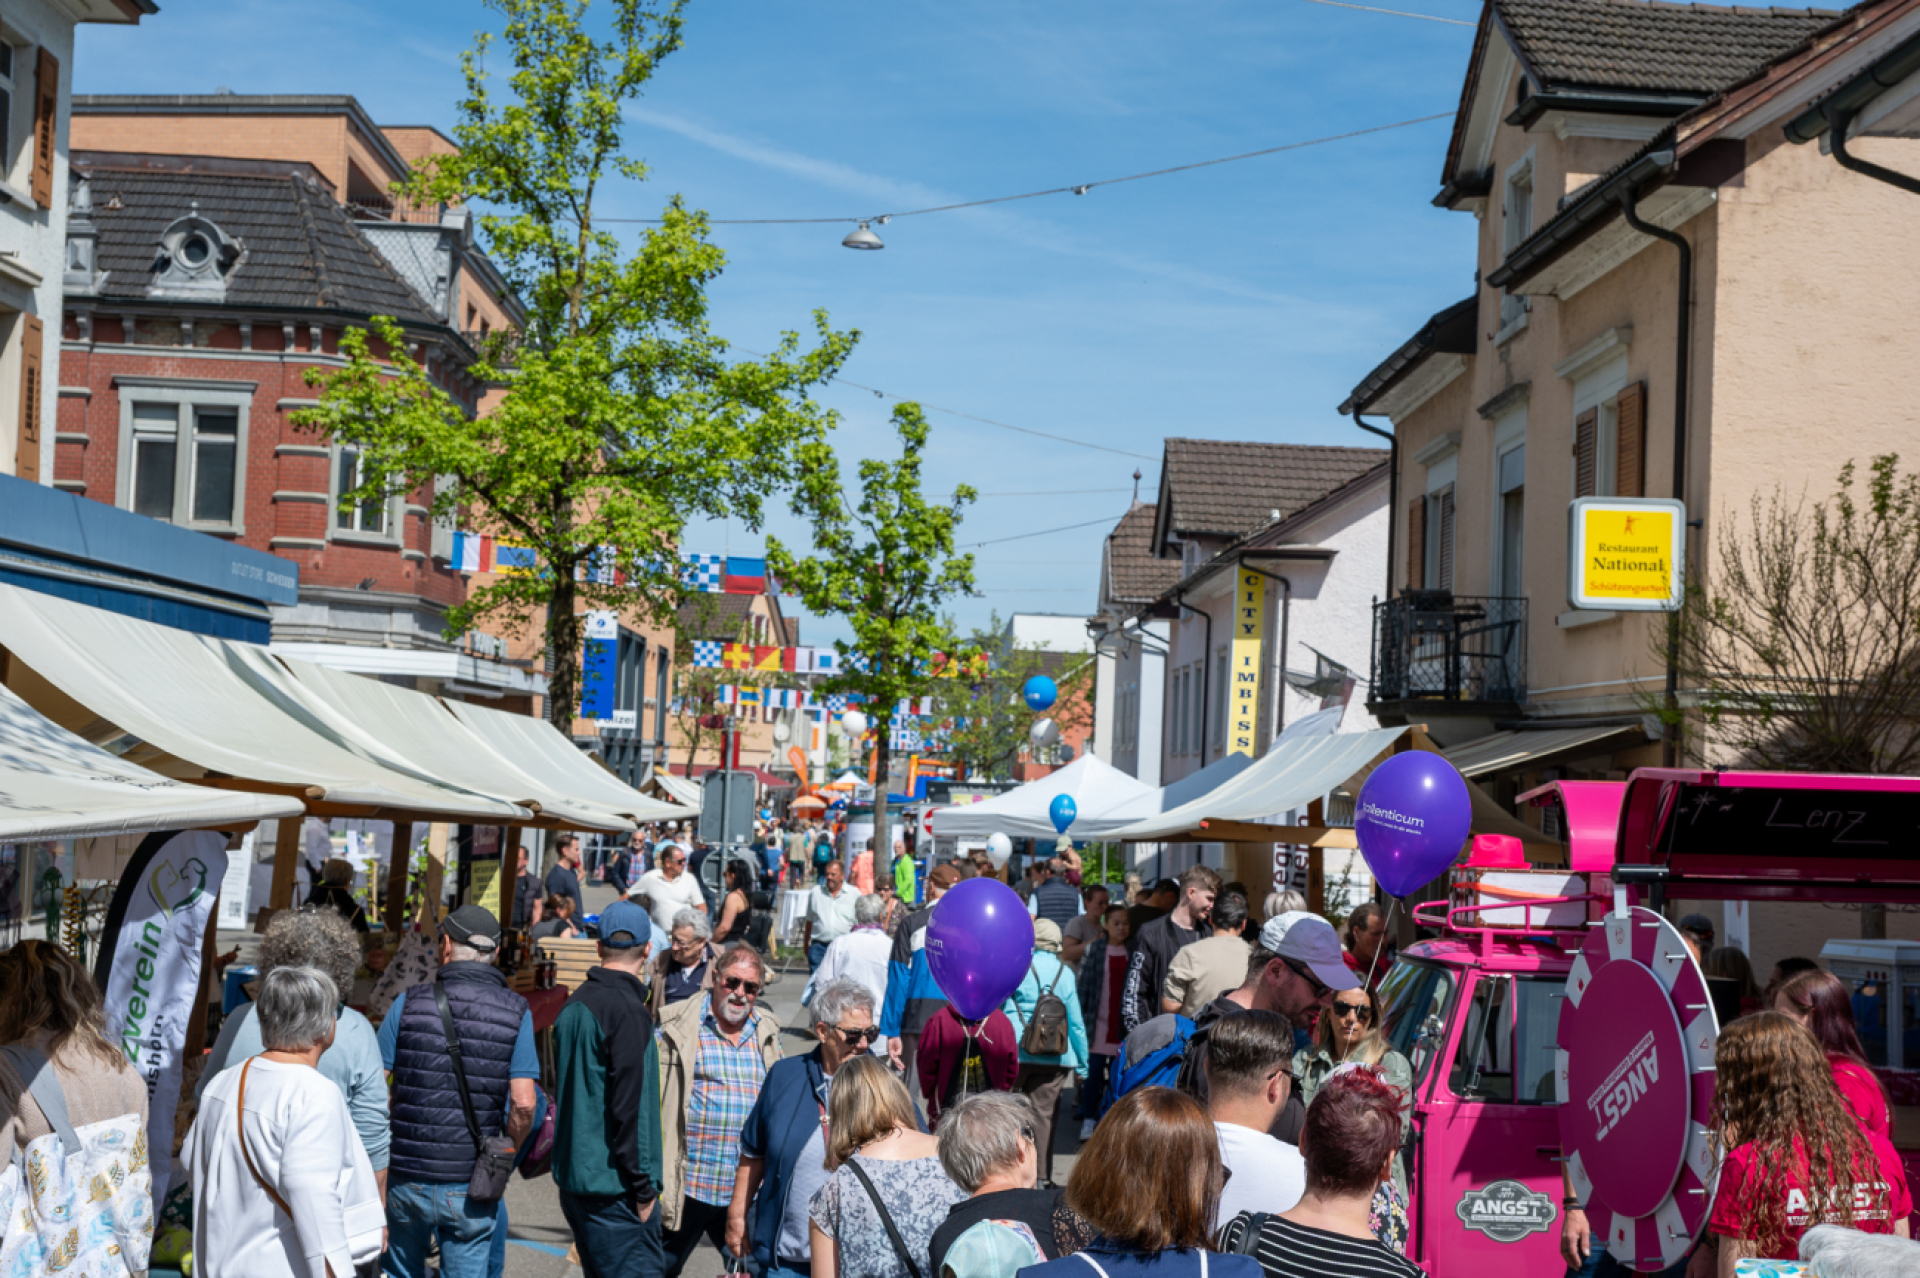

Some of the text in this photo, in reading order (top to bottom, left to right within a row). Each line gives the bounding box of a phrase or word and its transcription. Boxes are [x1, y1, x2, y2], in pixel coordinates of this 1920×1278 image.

[1593, 557, 1665, 572] National
[1598, 542, 1659, 555] Restaurant
[1237, 575, 1259, 748] CITY IMBISS
[1765, 797, 1889, 844] Lenz
[122, 920, 162, 1068] zverein
[146, 1014, 164, 1102] nshorn
[1595, 1045, 1660, 1142] ANGST
[1472, 1199, 1543, 1218] ANGST
